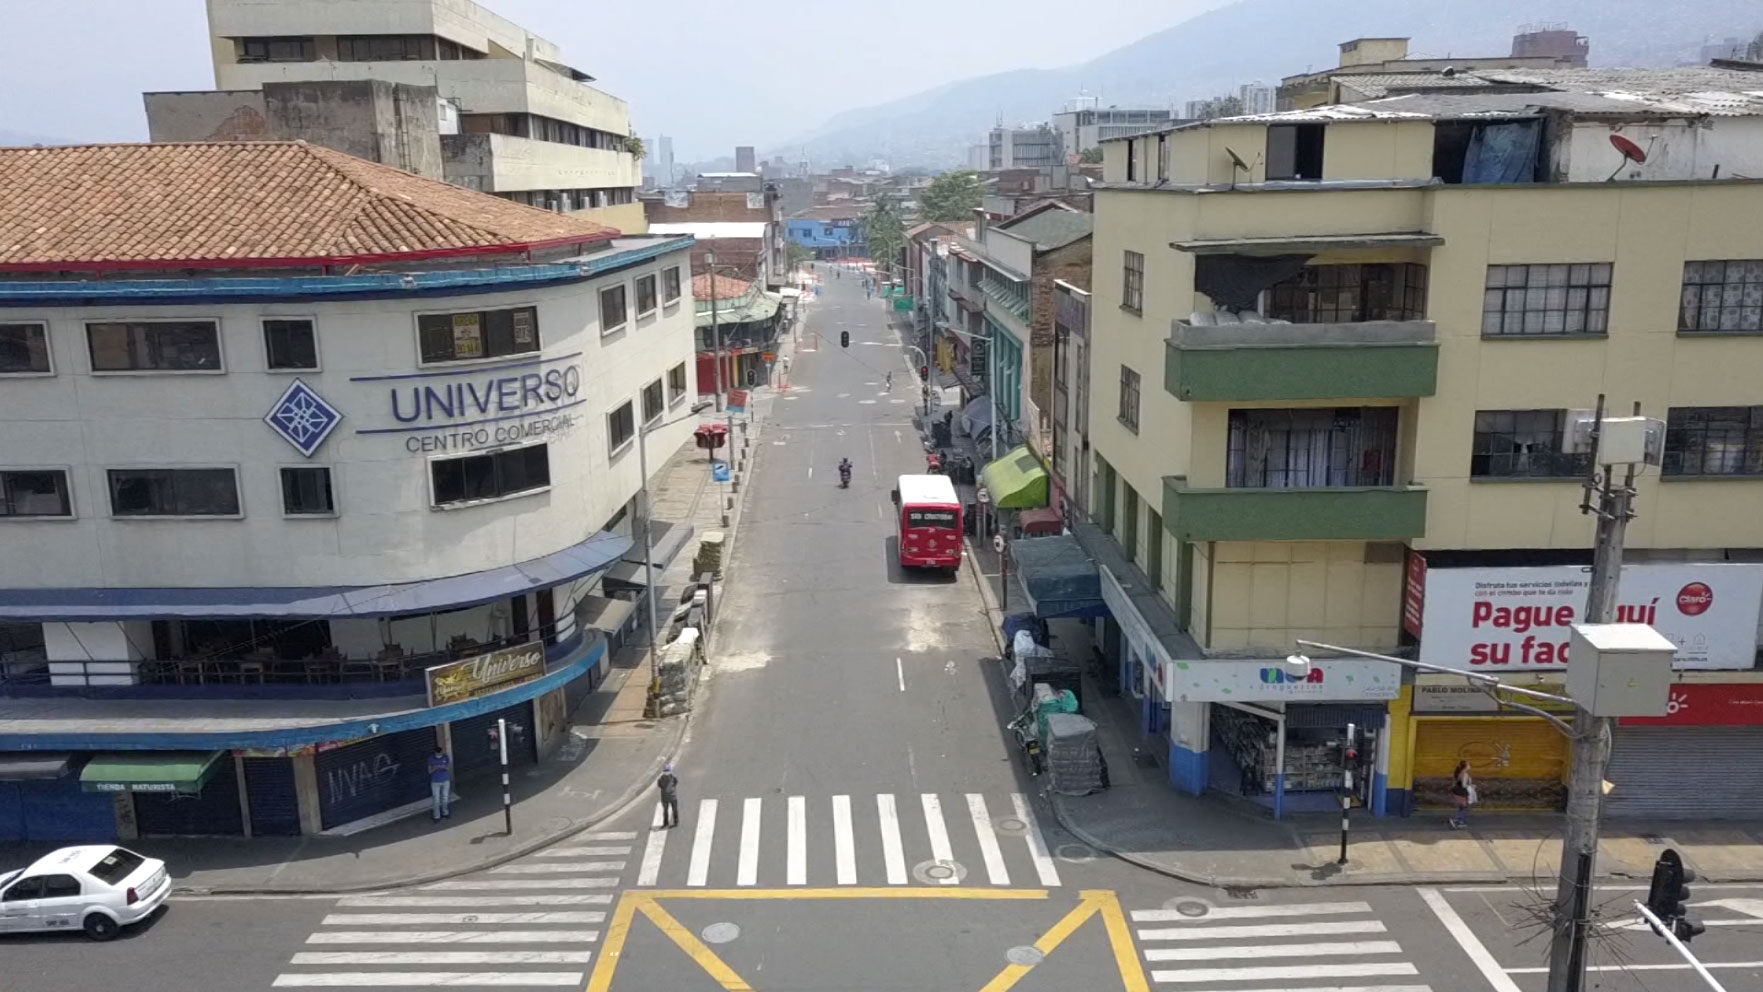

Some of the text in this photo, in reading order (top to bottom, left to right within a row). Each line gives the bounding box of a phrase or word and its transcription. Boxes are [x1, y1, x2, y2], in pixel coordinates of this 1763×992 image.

[391, 365, 580, 423] UNIVERSO
[406, 414, 576, 453] CENTRO COMERCIAL
[1472, 597, 1660, 633] Pague uí
[1679, 594, 1706, 604] Claro
[1469, 635, 1570, 665] su fac
[461, 651, 541, 683] Universo
[96, 783, 176, 791] TIENDA NATURISTA
